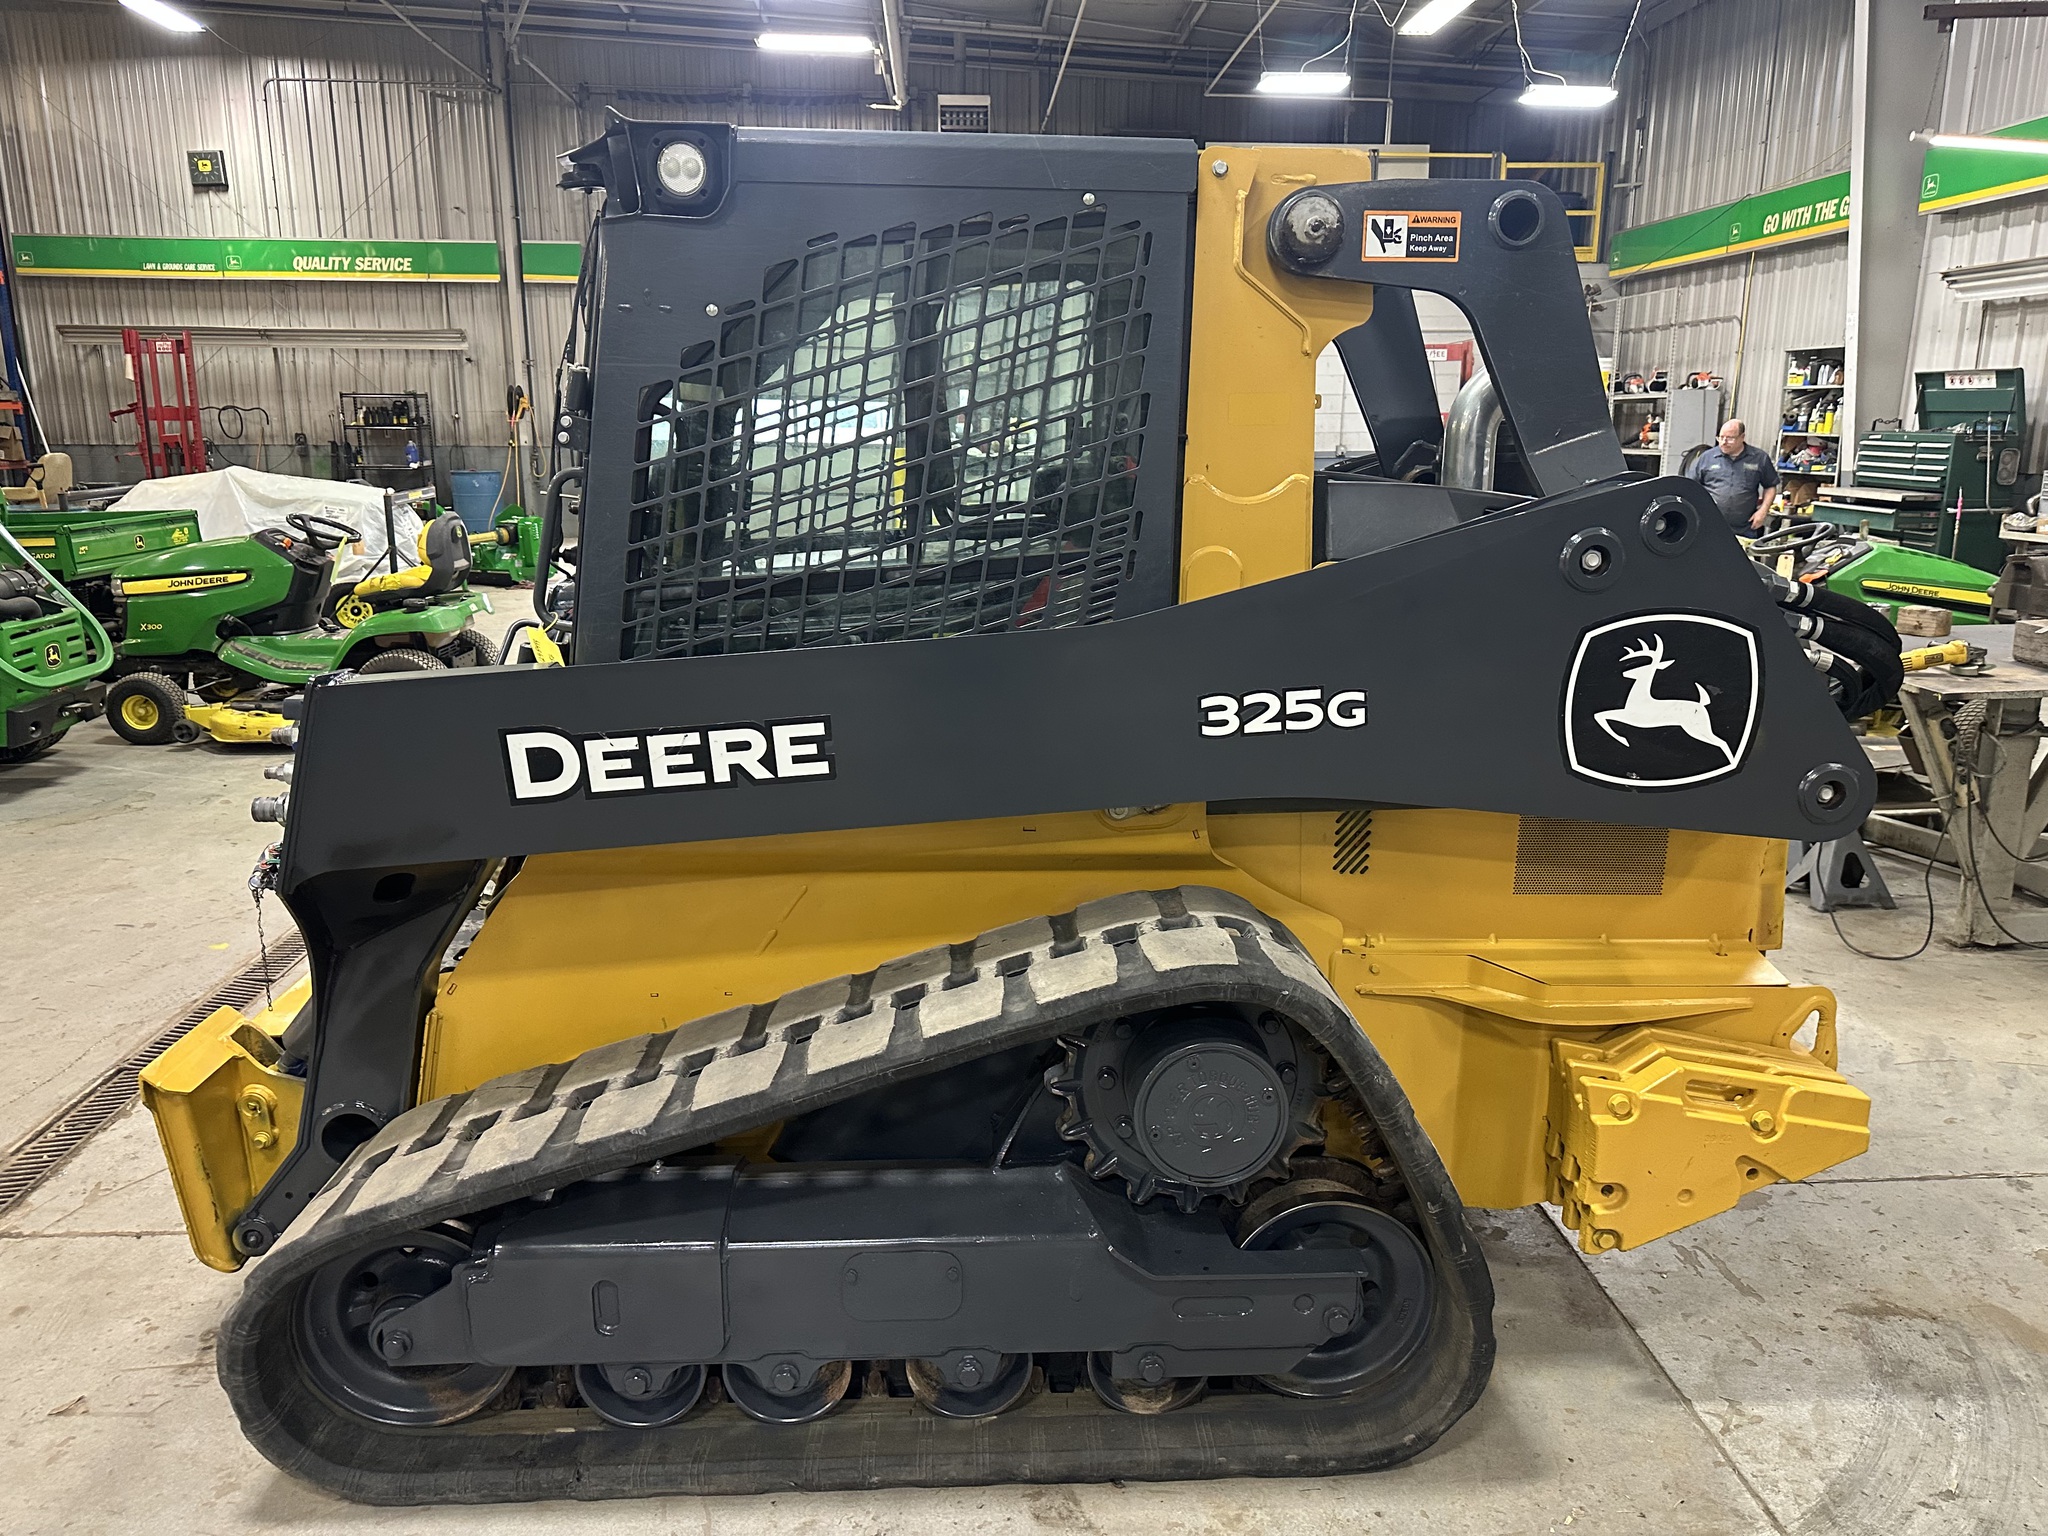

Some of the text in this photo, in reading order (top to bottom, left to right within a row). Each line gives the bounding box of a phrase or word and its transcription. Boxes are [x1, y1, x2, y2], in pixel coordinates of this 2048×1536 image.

[1420, 216, 1456, 224] WARNING
[1763, 195, 1850, 235] GO WITH THE G
[1410, 233, 1454, 242] Pinch Area
[1409, 245, 1447, 253] Keep Away
[142, 262, 156, 270] LAWN
[162, 263, 183, 271] GROUNDS
[184, 263, 196, 271] CARE
[293, 256, 413, 272] QUALITY SERVICE
[168, 576, 229, 588] JOHN DEERE
[1886, 582, 1940, 597] JOHN DEERE
[140, 623, 163, 631] X300
[1200, 688, 1366, 737] 325G
[505, 722, 830, 799] DEERE
